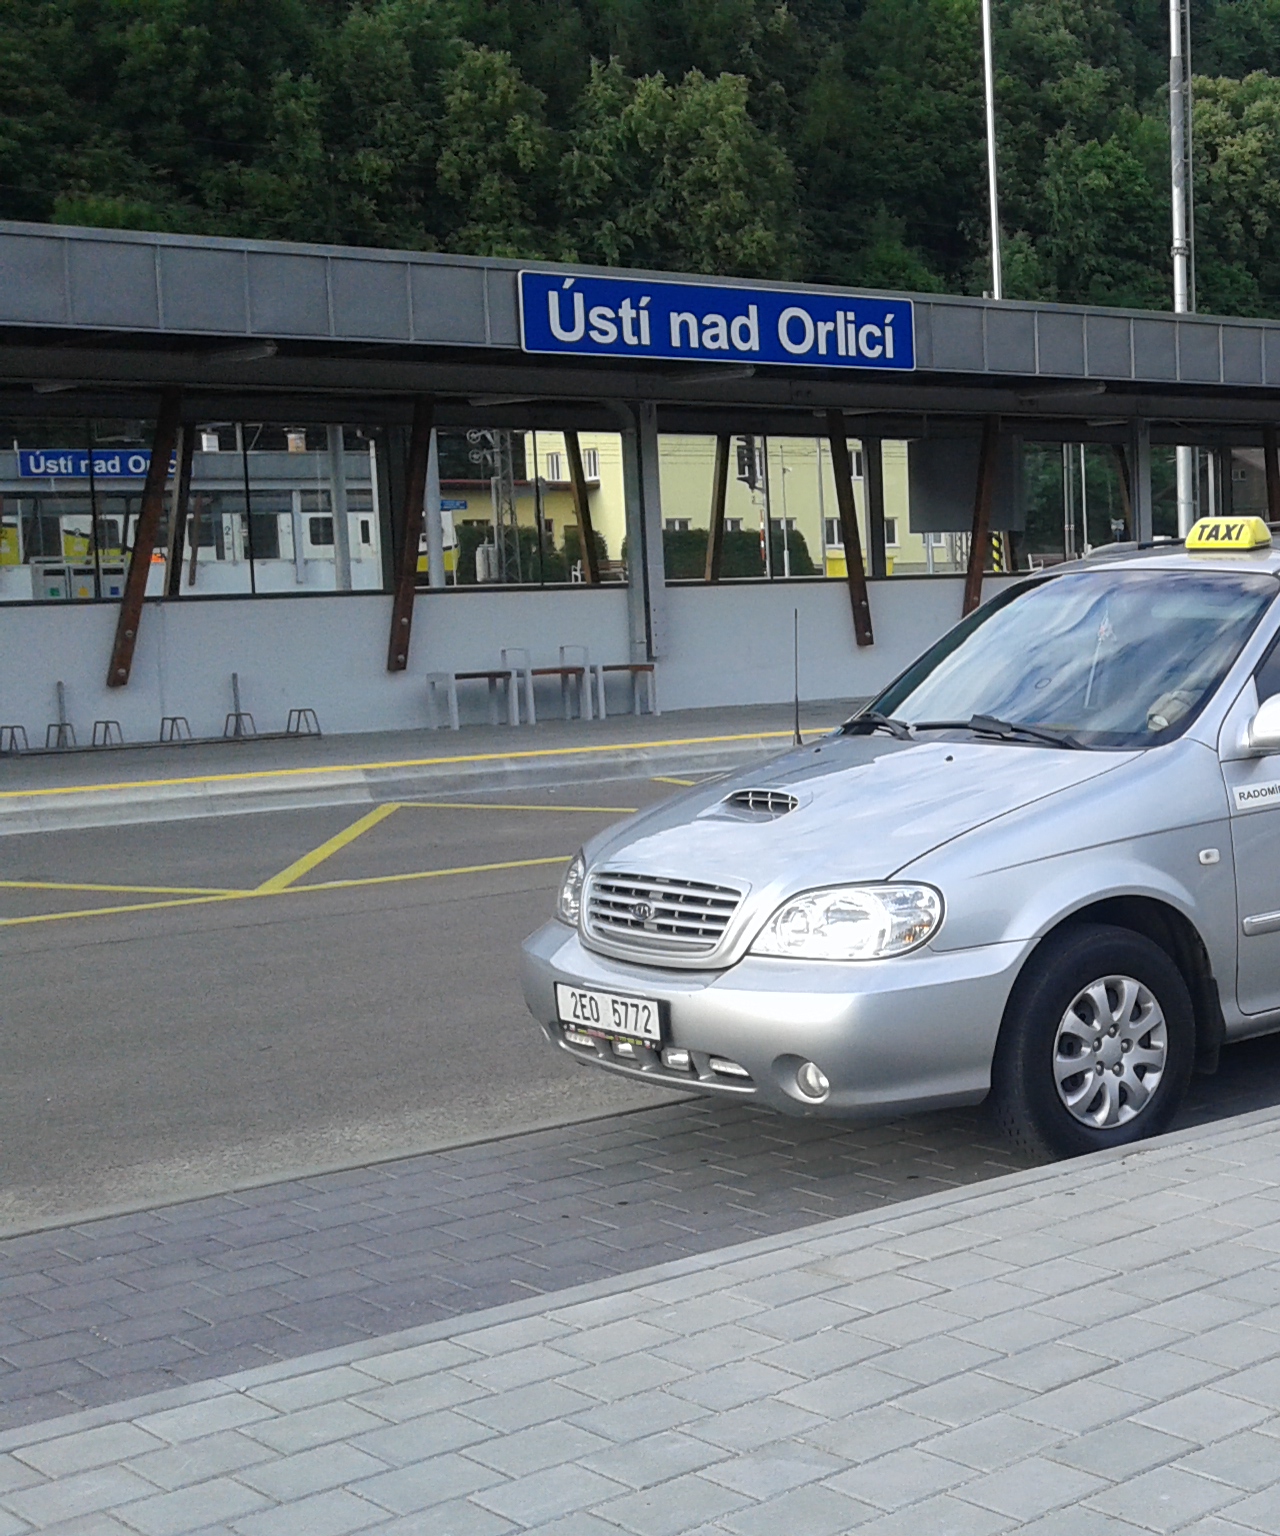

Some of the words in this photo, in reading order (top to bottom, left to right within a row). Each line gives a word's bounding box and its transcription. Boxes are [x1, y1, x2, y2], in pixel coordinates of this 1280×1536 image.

[547, 278, 652, 346] Ústí
[670, 304, 760, 351] nad
[778, 306, 896, 359] Orlicí
[29, 451, 73, 474] Ústí
[80, 455, 121, 473] nad
[1197, 523, 1246, 541] TAXI
[611, 999, 652, 1034] 5772
